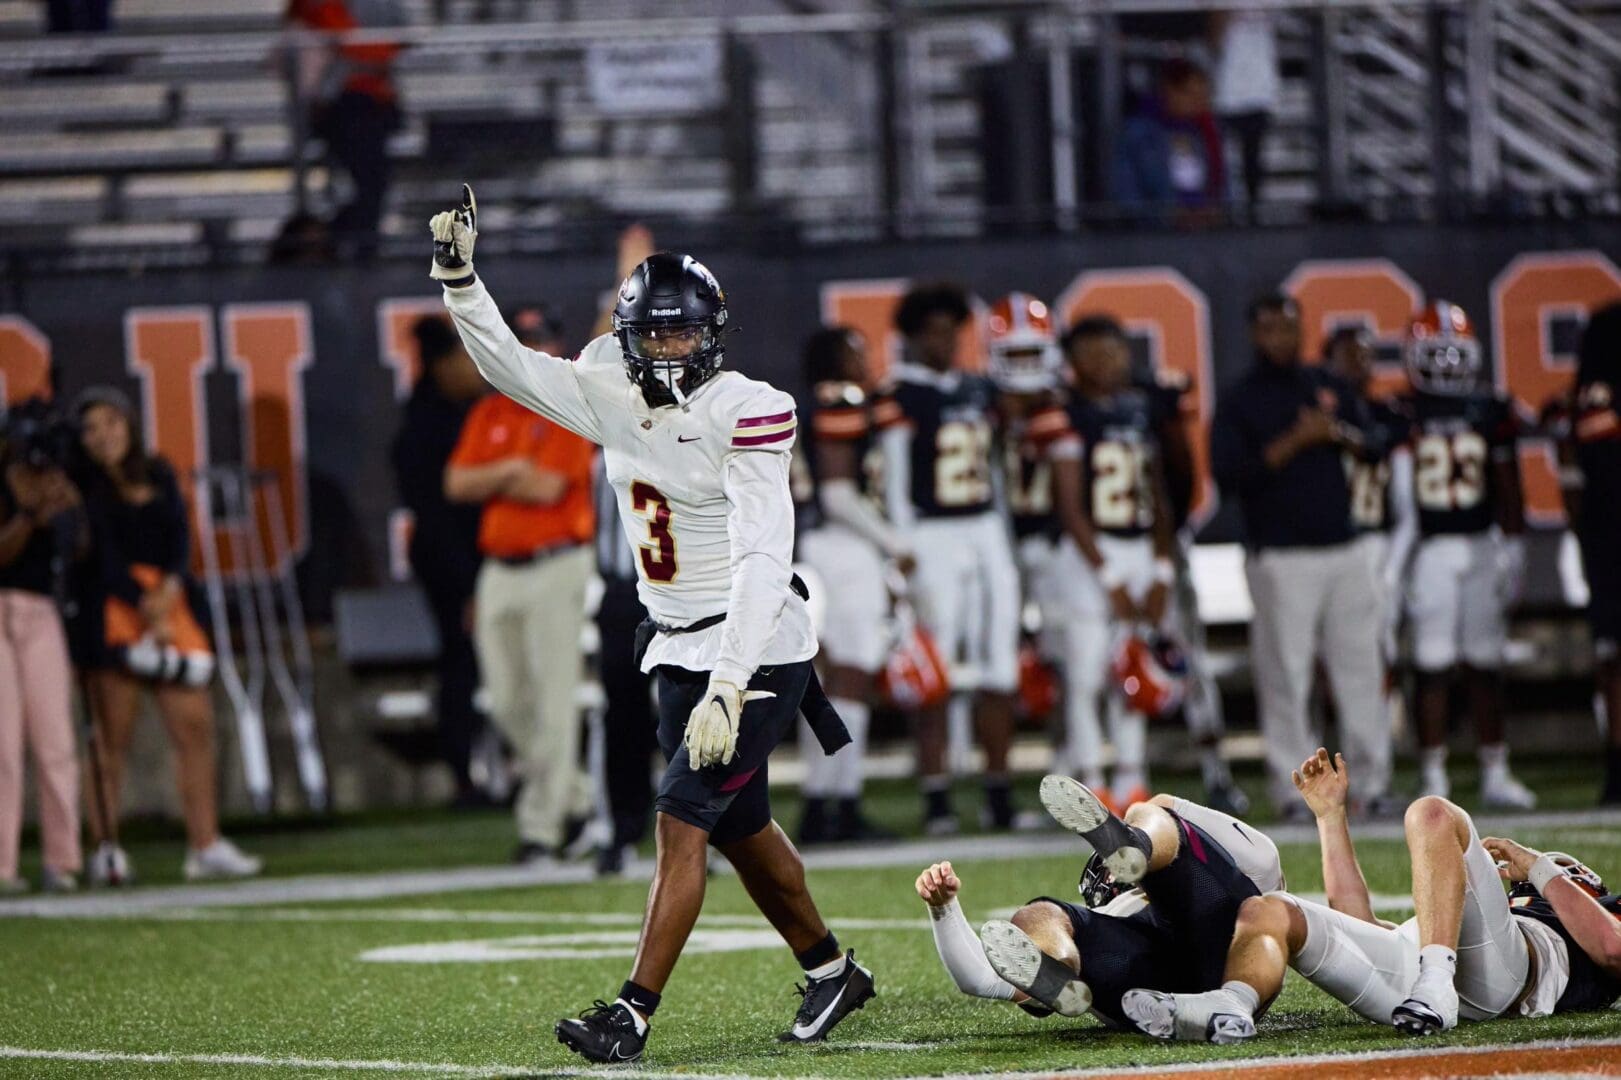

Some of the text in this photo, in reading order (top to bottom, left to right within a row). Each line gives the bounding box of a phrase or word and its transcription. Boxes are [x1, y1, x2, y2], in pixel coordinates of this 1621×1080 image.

[651, 307, 681, 316] Riddell
[1417, 431, 1487, 510] 23
[629, 478, 679, 584] 3
